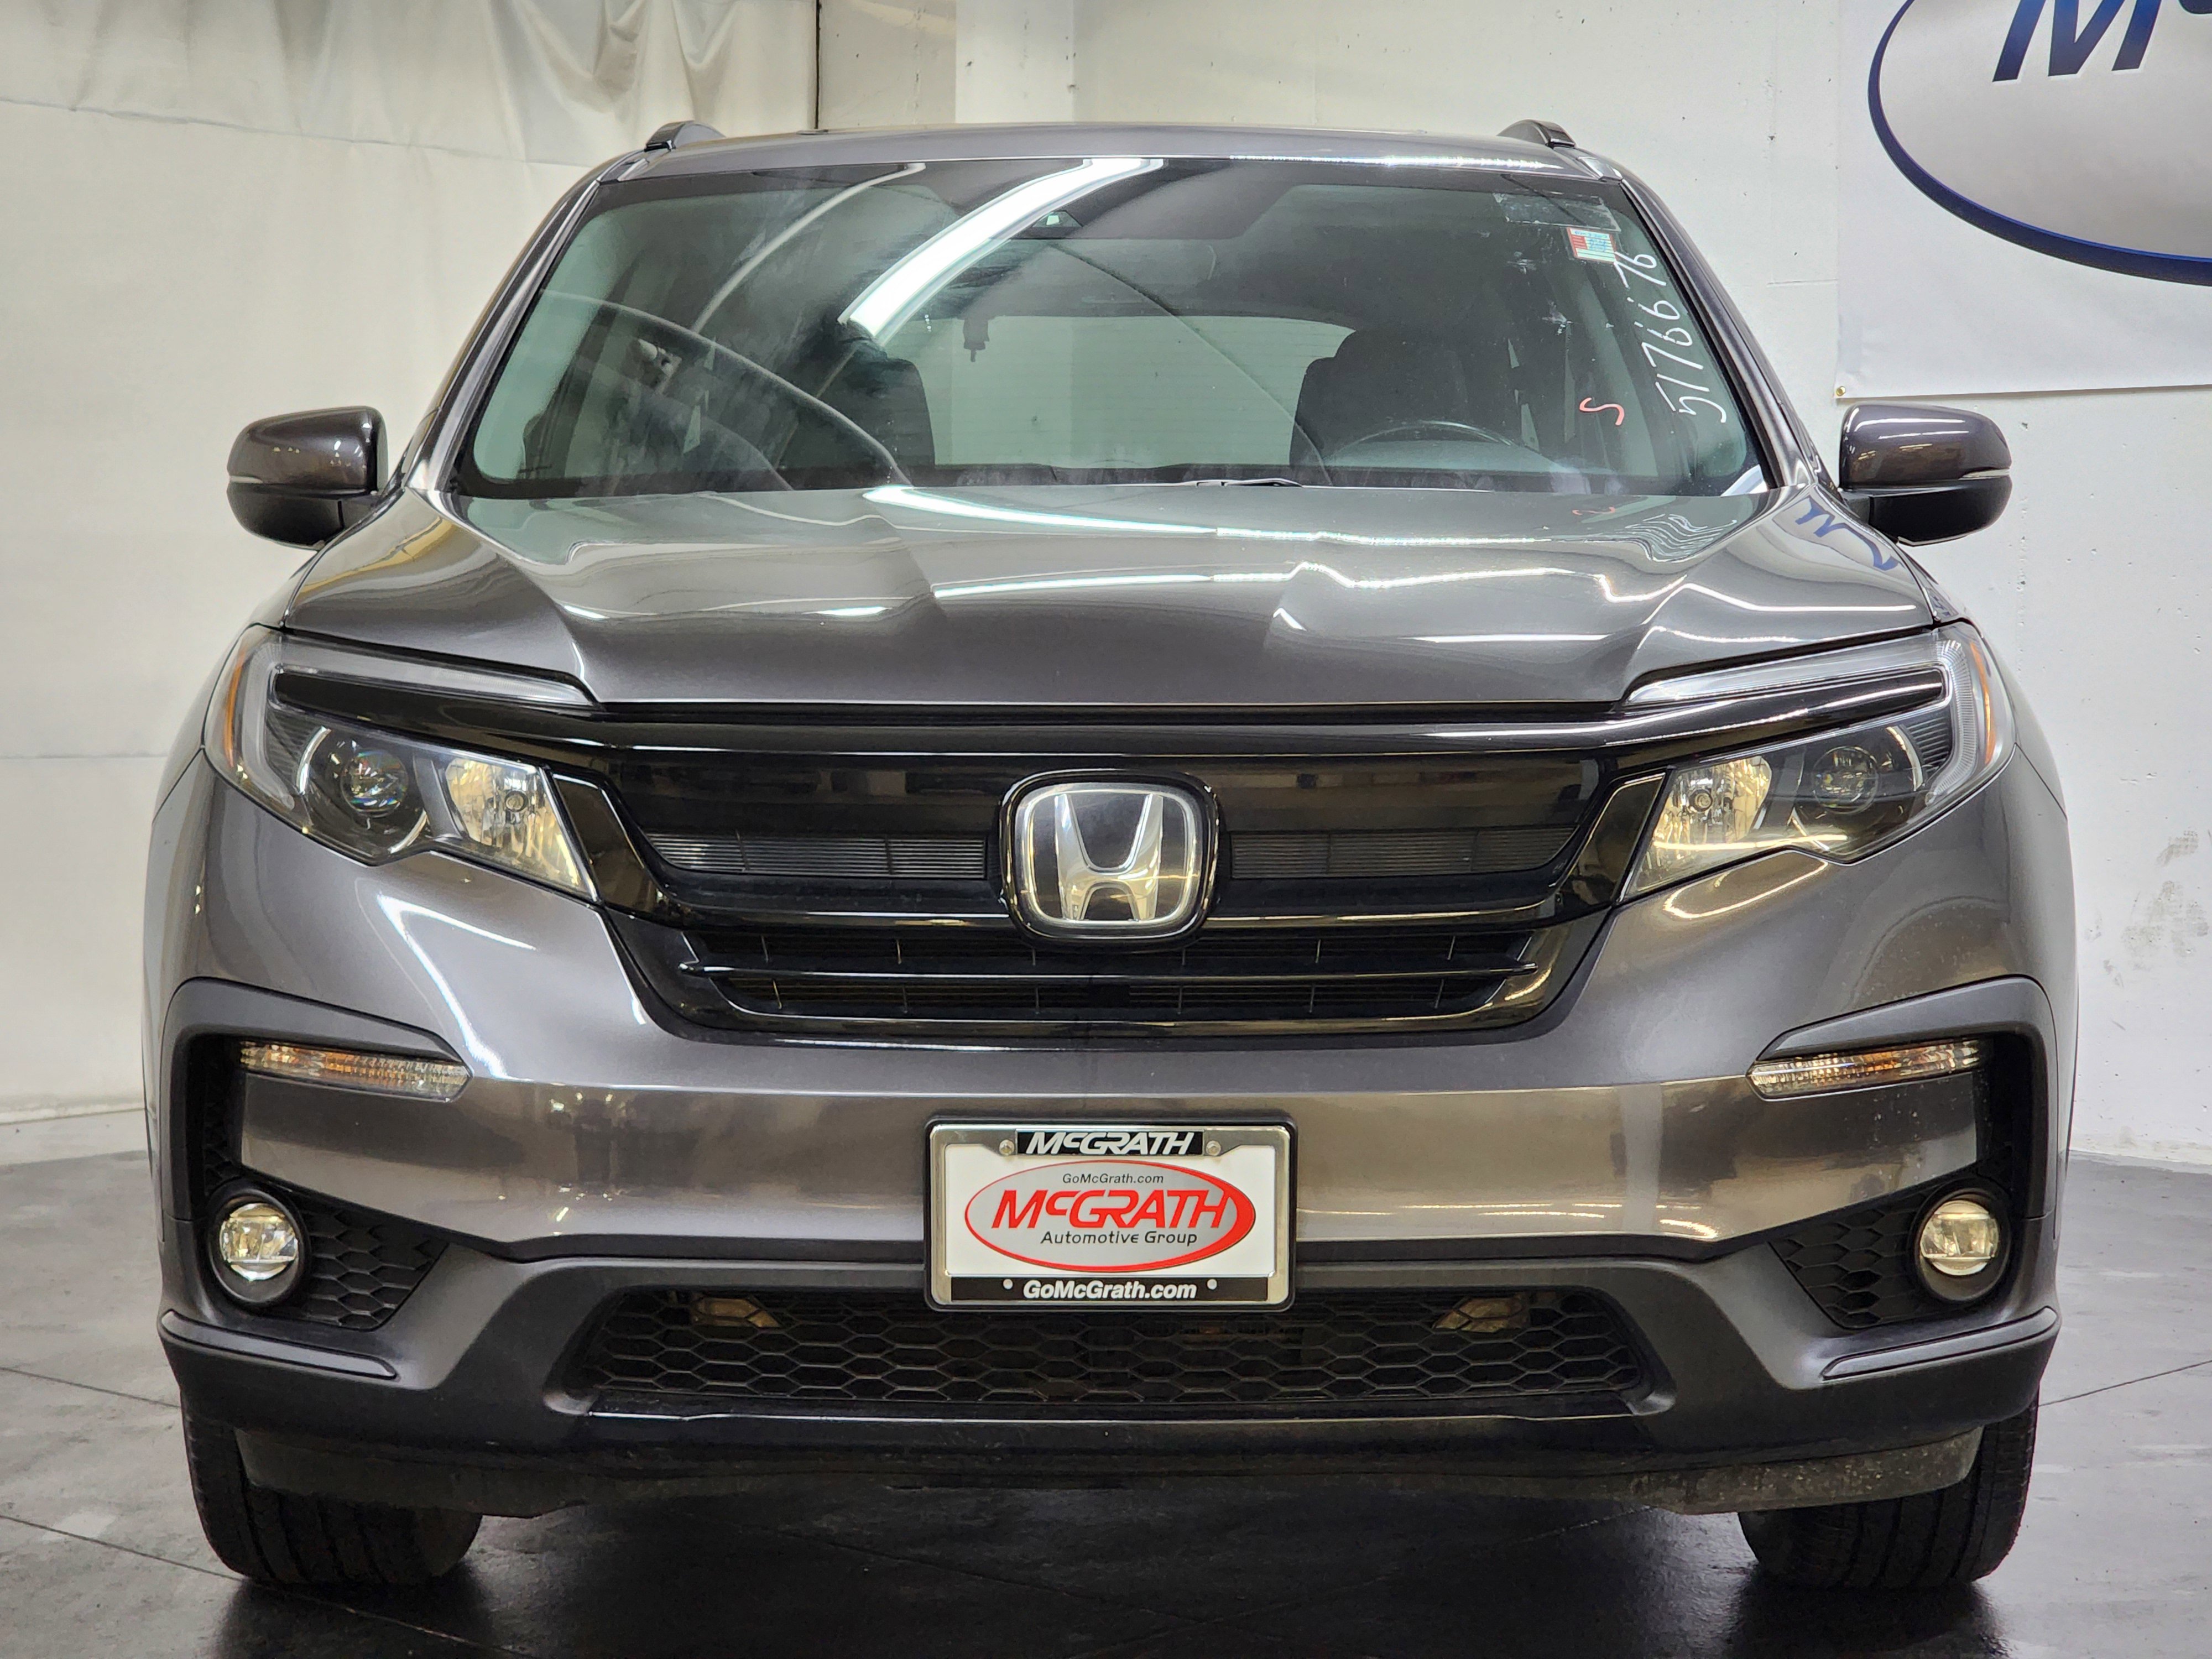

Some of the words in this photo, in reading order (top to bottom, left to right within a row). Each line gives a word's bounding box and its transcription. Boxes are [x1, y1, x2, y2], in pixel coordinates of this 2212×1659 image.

[1062, 1173, 1165, 1185] GoMcGrath.com
[1040, 1230, 1139, 1245] Automotive
[1144, 1230, 1198, 1247] Group
[1022, 1279, 1197, 1300] GoMcGrath.com
